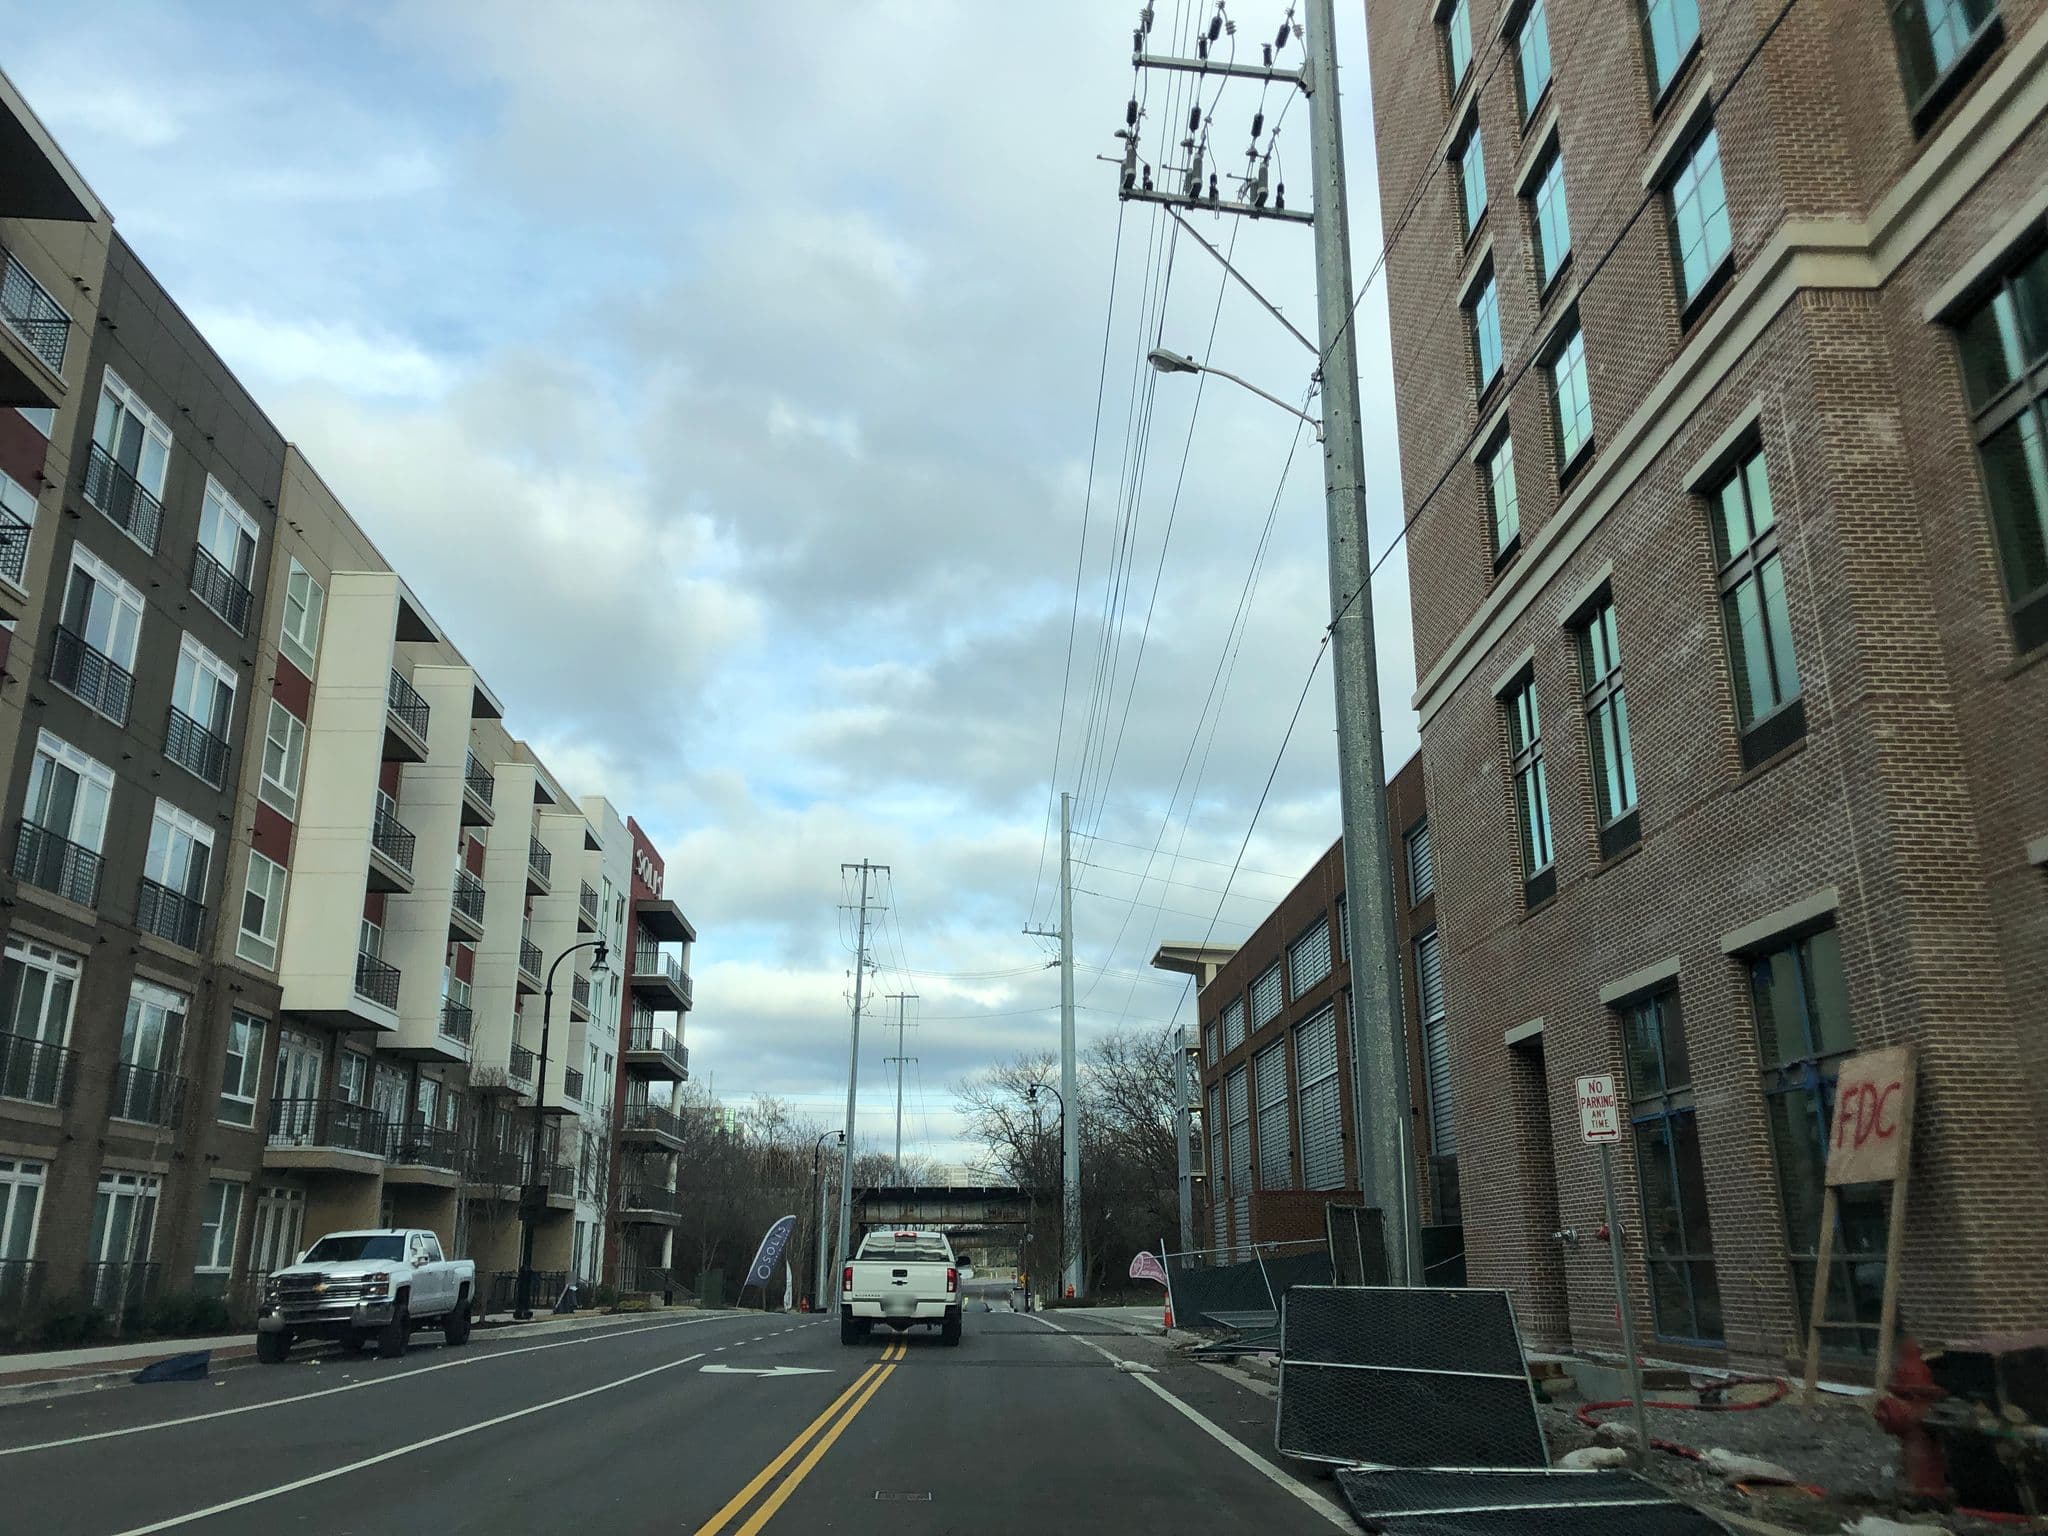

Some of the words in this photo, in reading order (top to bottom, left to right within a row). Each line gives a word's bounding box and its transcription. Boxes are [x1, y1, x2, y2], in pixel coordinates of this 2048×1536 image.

[1588, 1081, 1603, 1094] NO
[1580, 1095, 1614, 1109] PARKING
[1592, 1109, 1606, 1118] ANY
[1837, 1081, 1900, 1150] FDC
[1591, 1119, 1610, 1128] TIME
